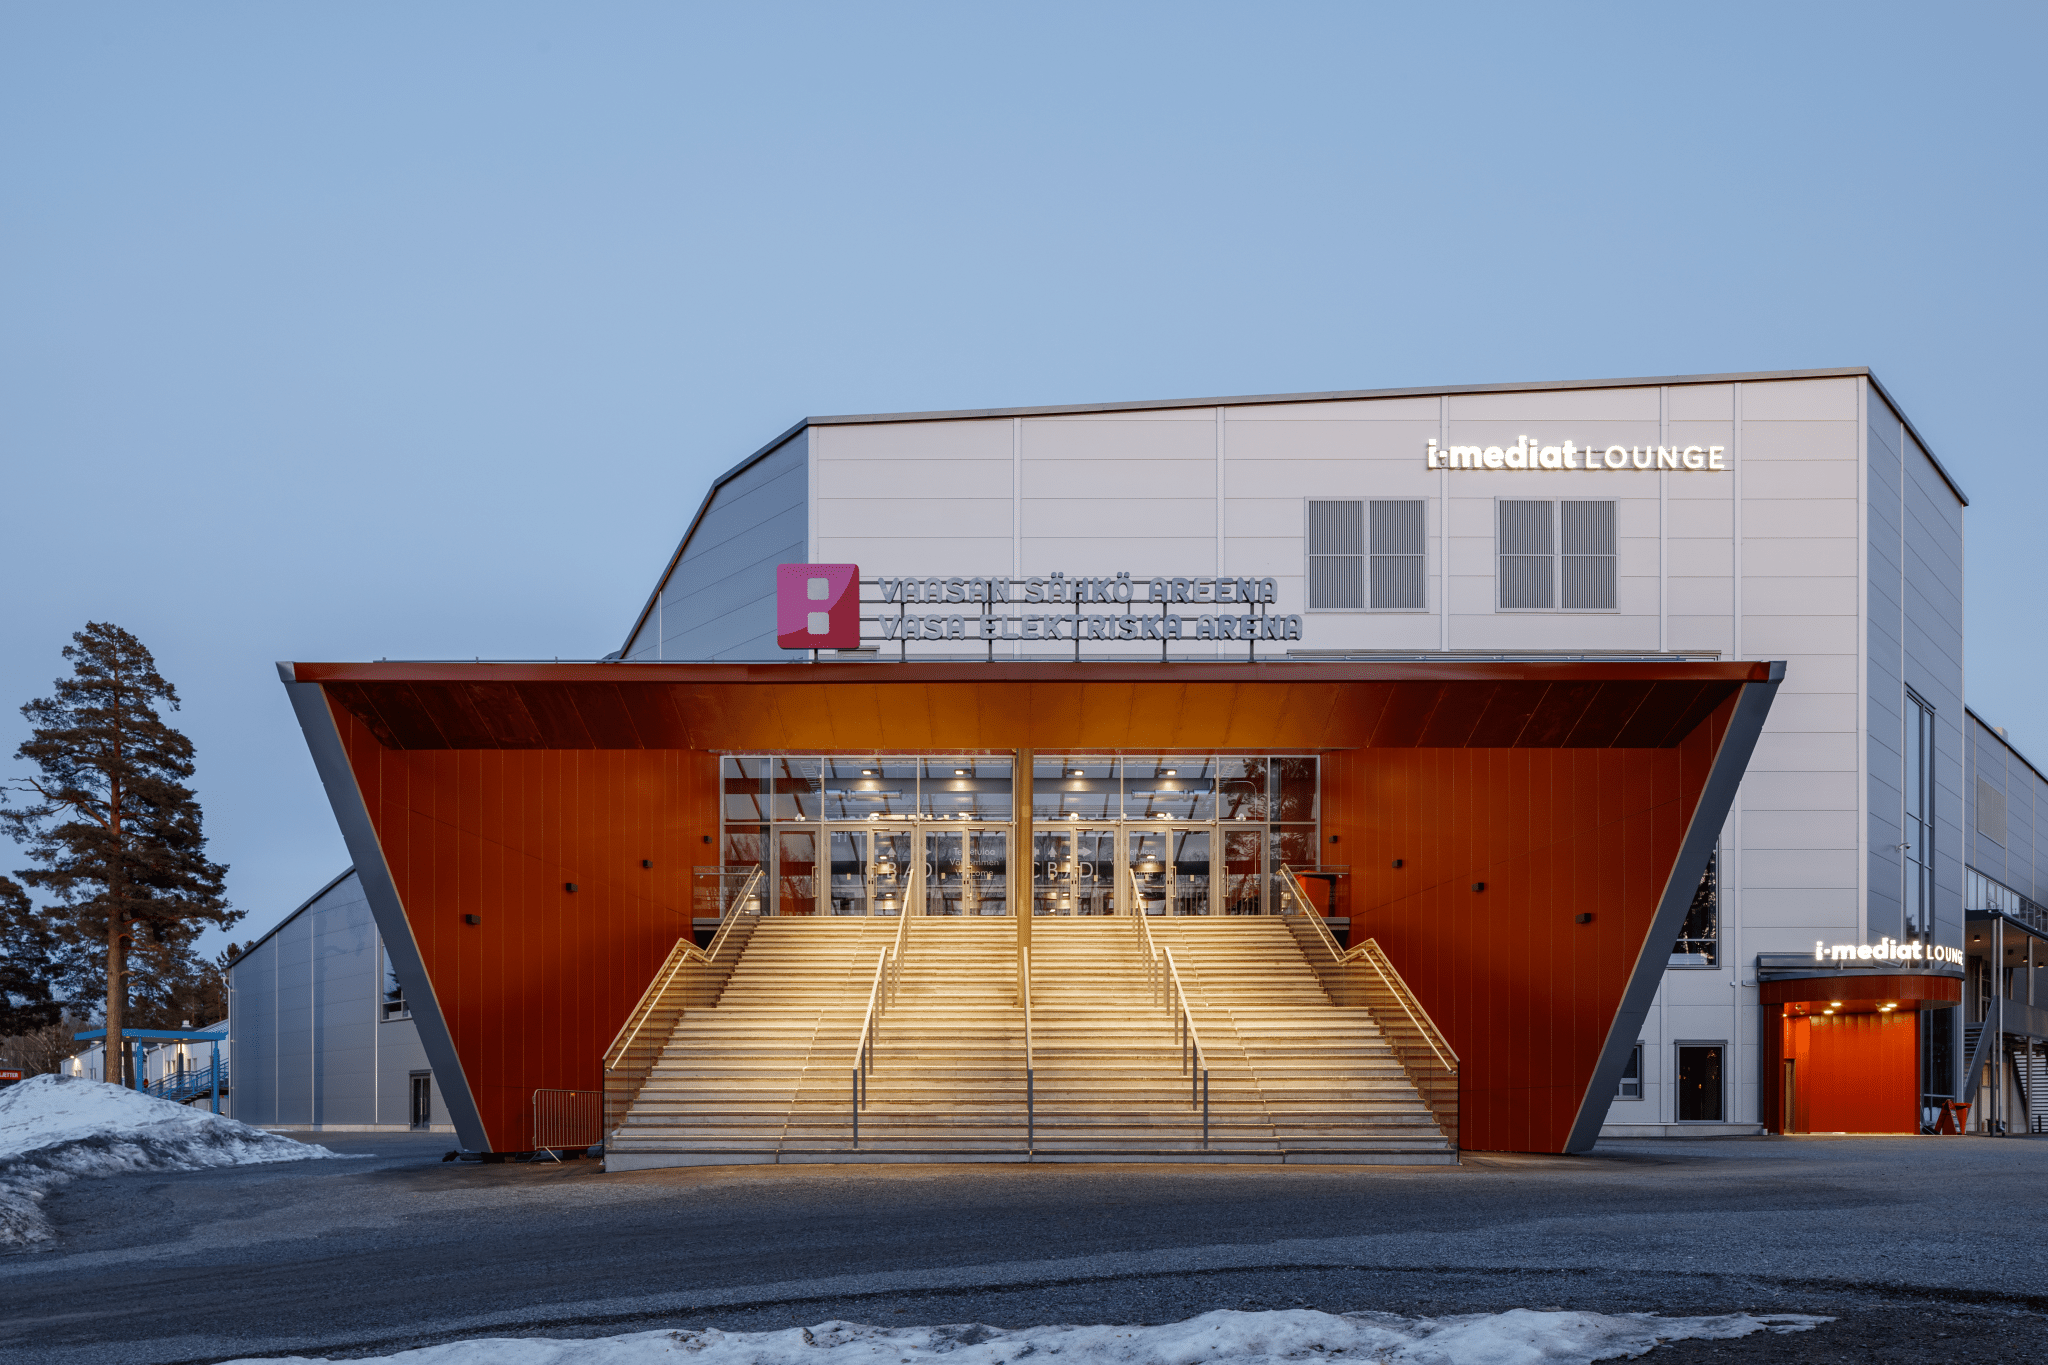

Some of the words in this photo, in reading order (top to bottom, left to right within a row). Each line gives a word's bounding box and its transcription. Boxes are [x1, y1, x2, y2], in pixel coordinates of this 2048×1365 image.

[1428, 435, 1577, 469] i-mediat
[1585, 445, 1725, 469] LOUNGE
[878, 577, 1010, 604] VAASAN
[1024, 571, 1135, 604] SÄHKÖ
[1148, 577, 1279, 604] AREENA
[878, 613, 963, 640] VASA
[979, 613, 1183, 641] ELEKTRISKA
[1196, 613, 1304, 641] ARENA
[949, 858, 1000, 866] Välommen
[953, 848, 996, 856] Teetuloa
[1047, 861, 1058, 878] B
[1079, 861, 1094, 878] D
[1815, 937, 1922, 961] i-mediat
